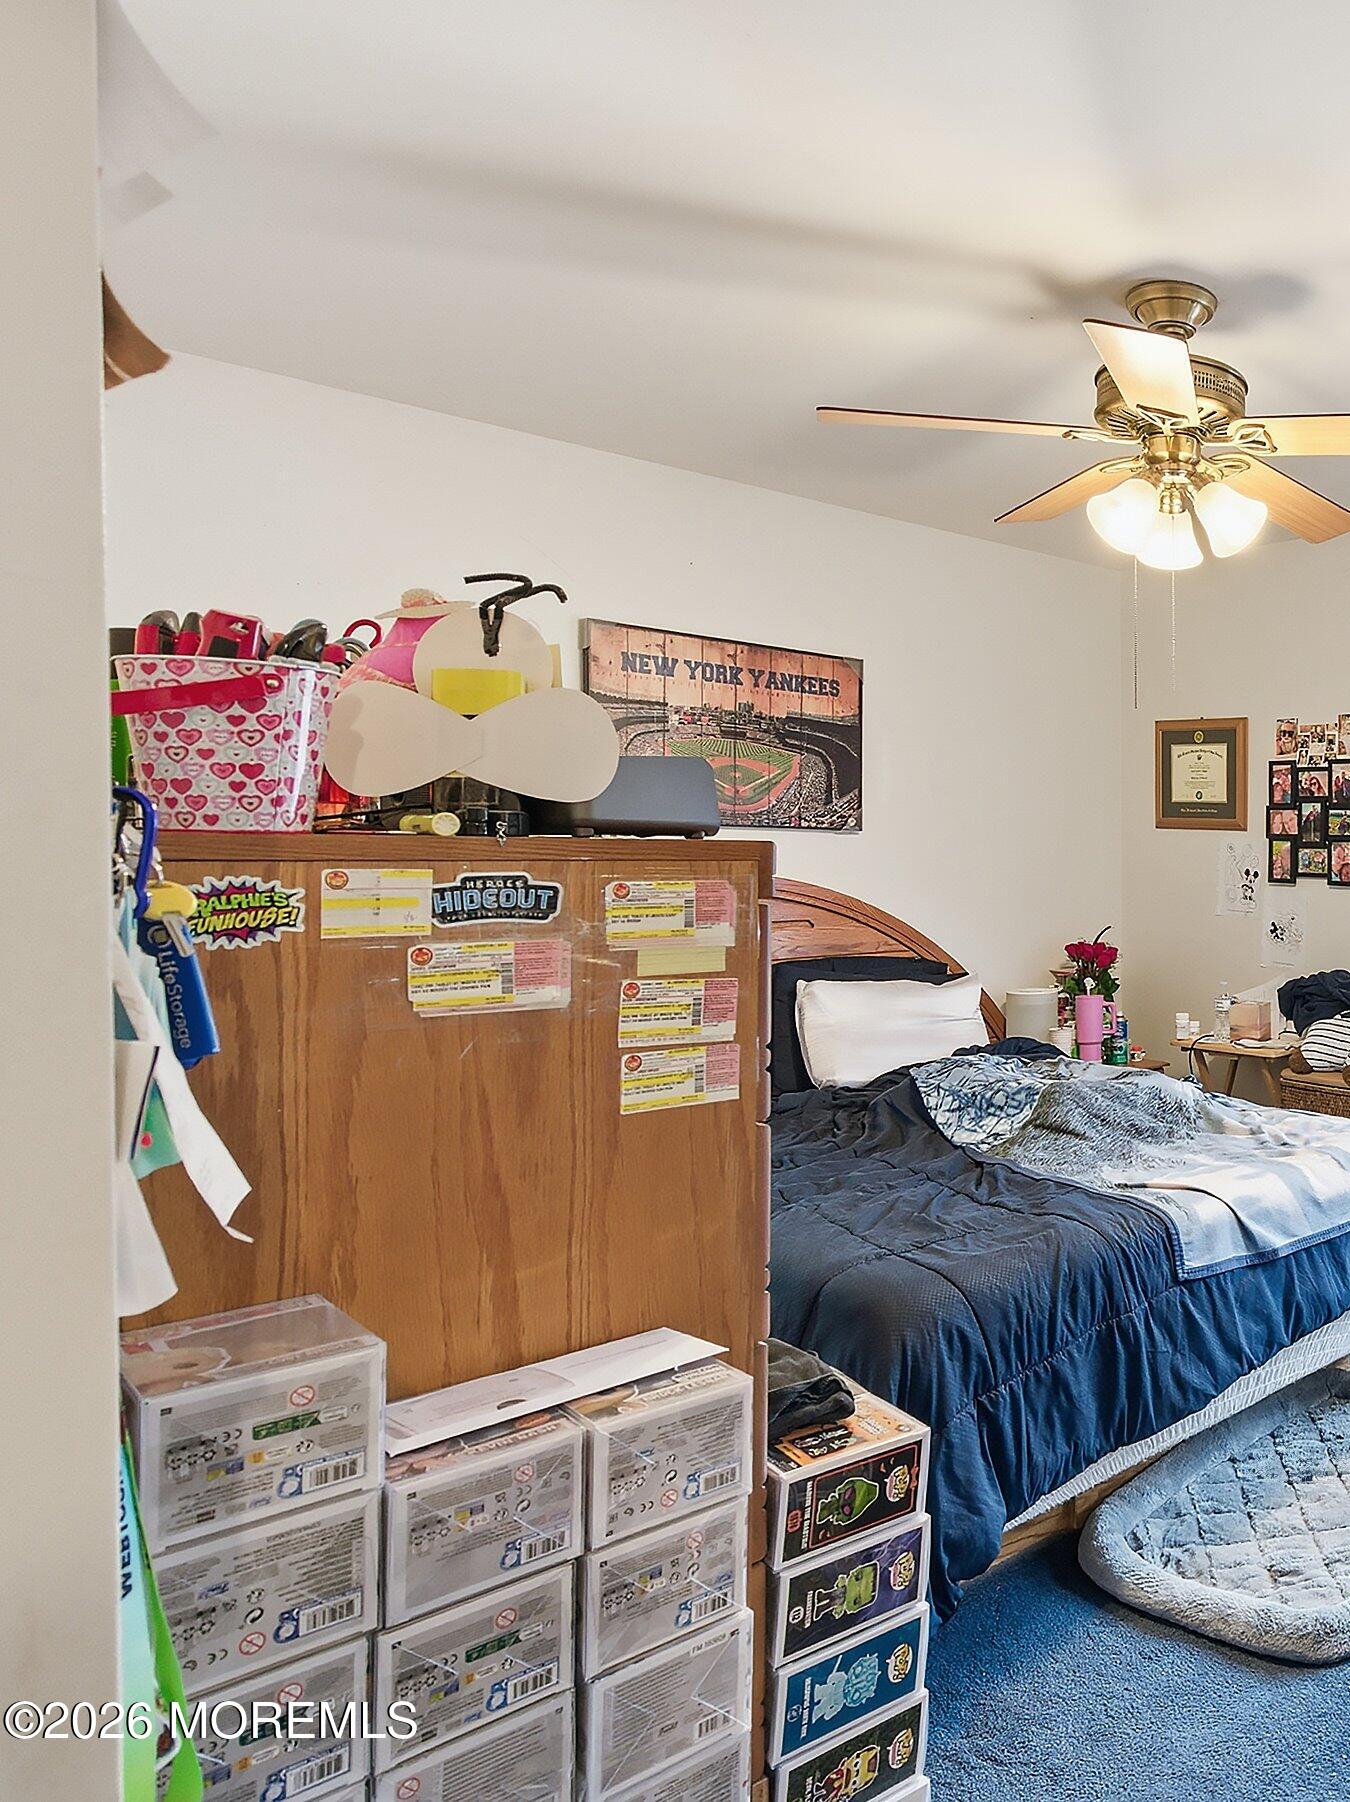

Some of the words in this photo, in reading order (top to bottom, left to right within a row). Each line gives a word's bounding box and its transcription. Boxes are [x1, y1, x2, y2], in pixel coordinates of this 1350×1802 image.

[620, 651, 679, 678] NEW
[683, 660, 745, 687] YORK
[749, 668, 840, 699] YANKEES
[432, 887, 555, 914] HIDEOUT
